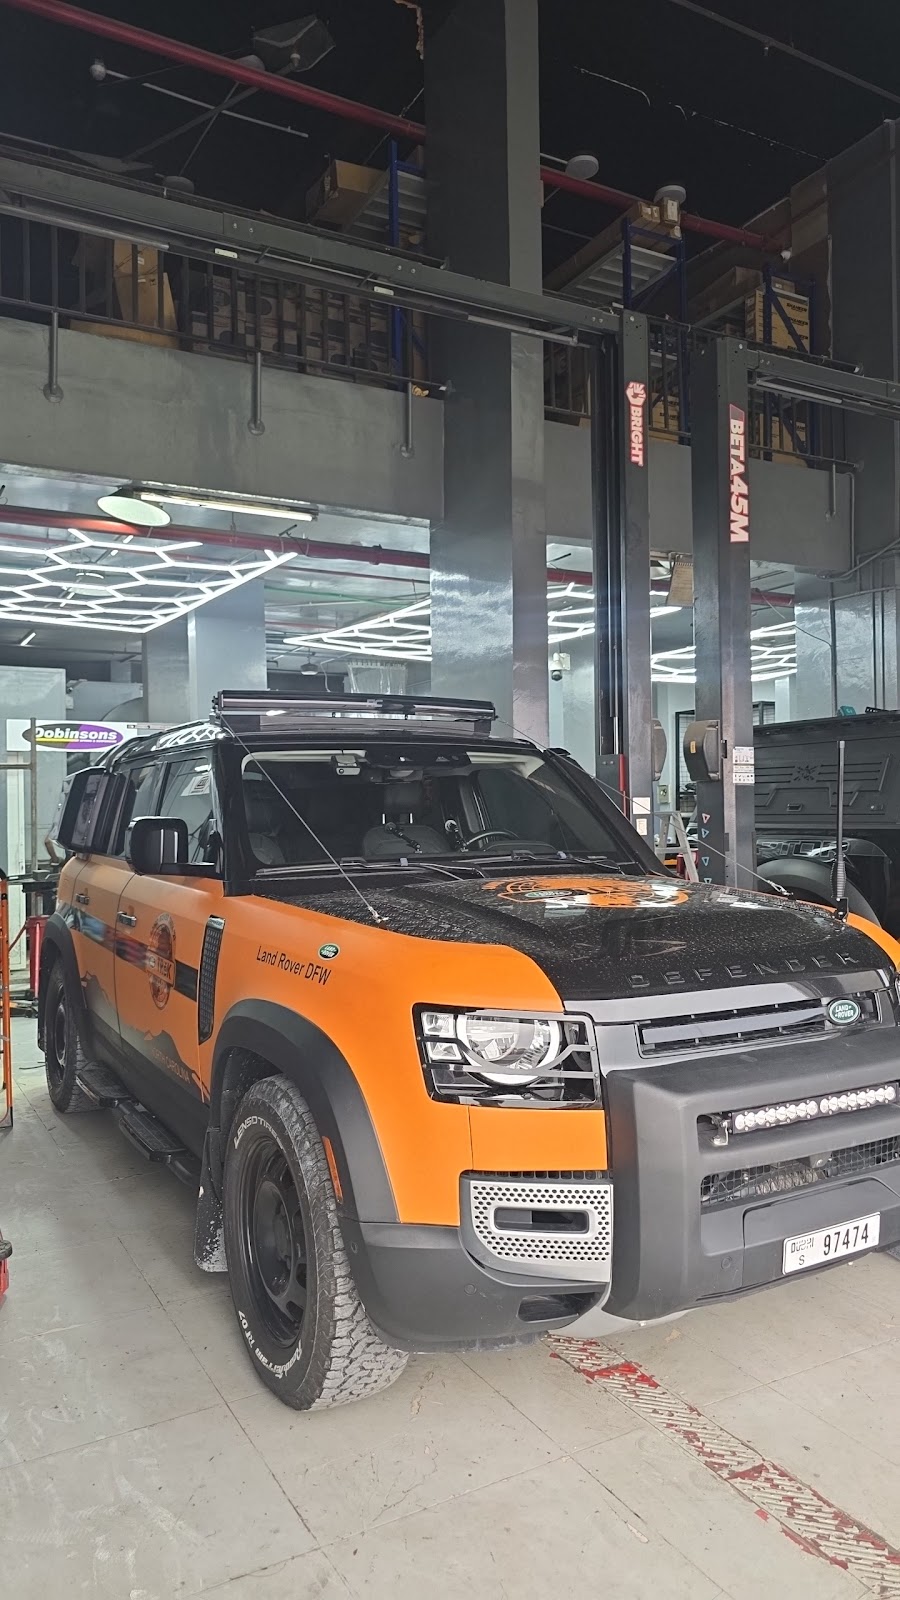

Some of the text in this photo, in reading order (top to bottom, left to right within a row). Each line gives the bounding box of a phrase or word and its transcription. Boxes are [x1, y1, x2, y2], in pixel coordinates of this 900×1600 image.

[630, 406, 644, 467] BRIGHT
[730, 419, 749, 543] BETA45M
[256, 945, 332, 986] Land Rover DFW
[626, 952, 859, 989] DEFENDER
[835, 1004, 852, 1012] LAND
[836, 1009, 854, 1019] ROVER
[233, 1115, 258, 1150] LENSO
[823, 1223, 869, 1256] 97474
[798, 1254, 805, 1266] S
